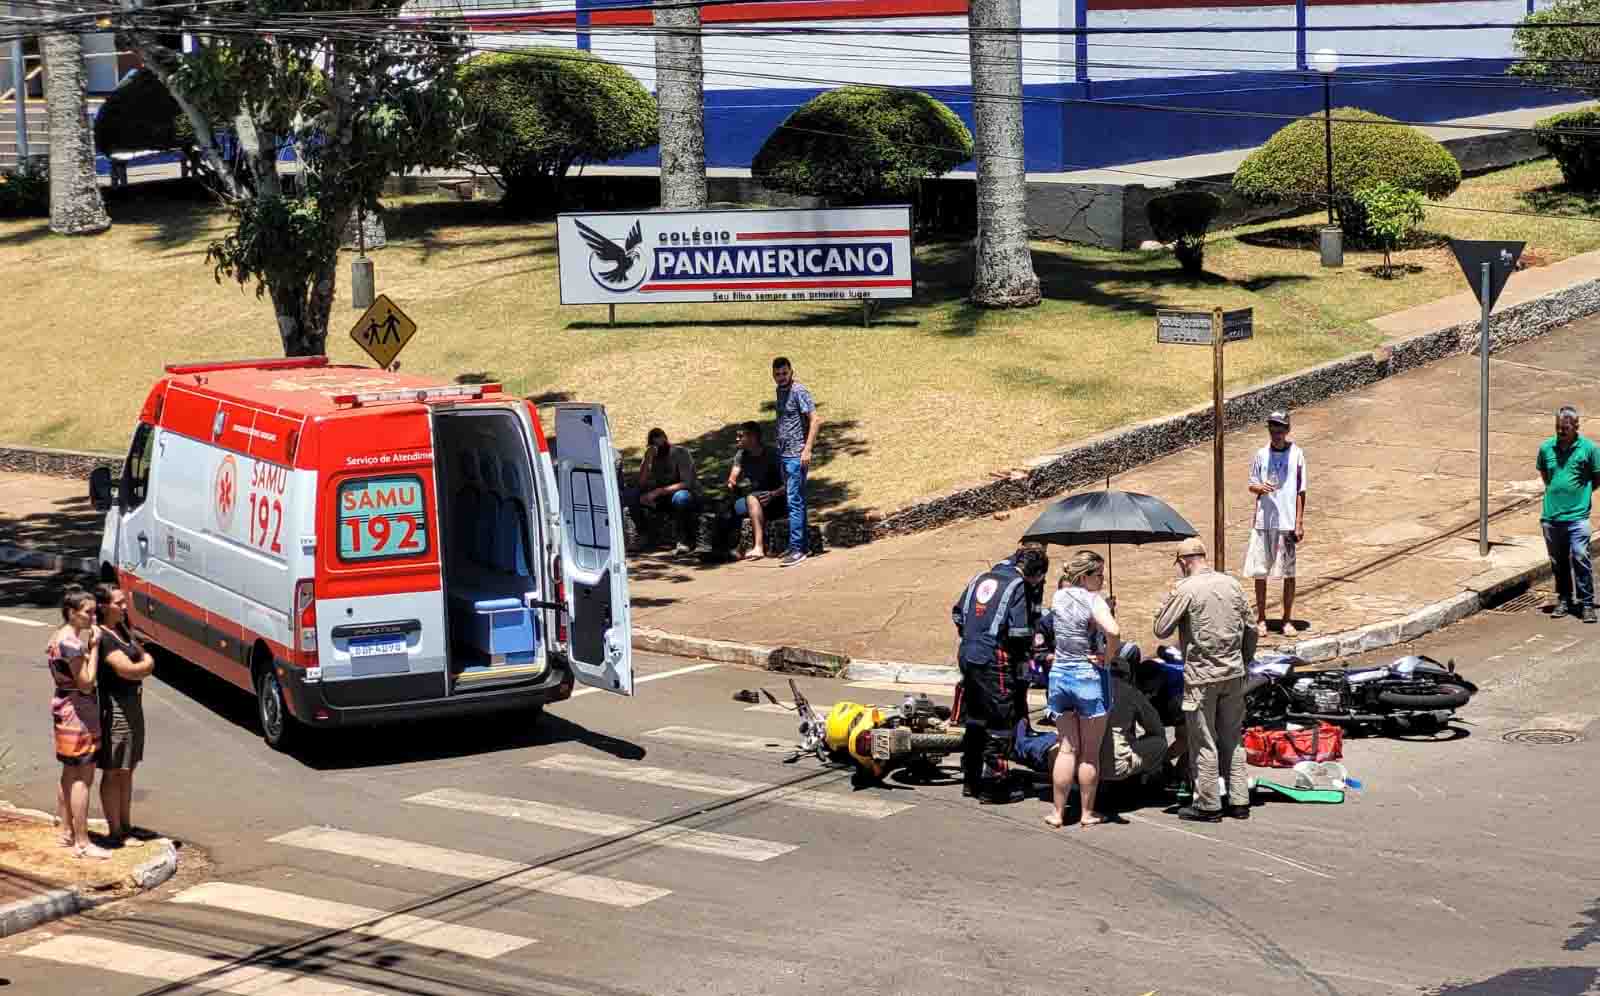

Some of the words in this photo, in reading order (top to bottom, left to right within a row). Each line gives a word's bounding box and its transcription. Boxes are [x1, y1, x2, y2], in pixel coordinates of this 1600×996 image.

[658, 226, 730, 243] COLÉGIO
[658, 247, 889, 276] PANAMERICANO
[712, 292, 729, 301] Seu
[732, 291, 752, 301] filho
[755, 291, 788, 302] sempre
[791, 292, 806, 300] em
[809, 289, 846, 300] primeiro
[848, 288, 872, 300] lugar
[345, 456, 379, 466] Serviço
[379, 455, 391, 464] de
[250, 460, 287, 495] SAMU
[342, 485, 416, 512] SAMU
[249, 492, 282, 553] 192
[343, 514, 420, 553] 192
